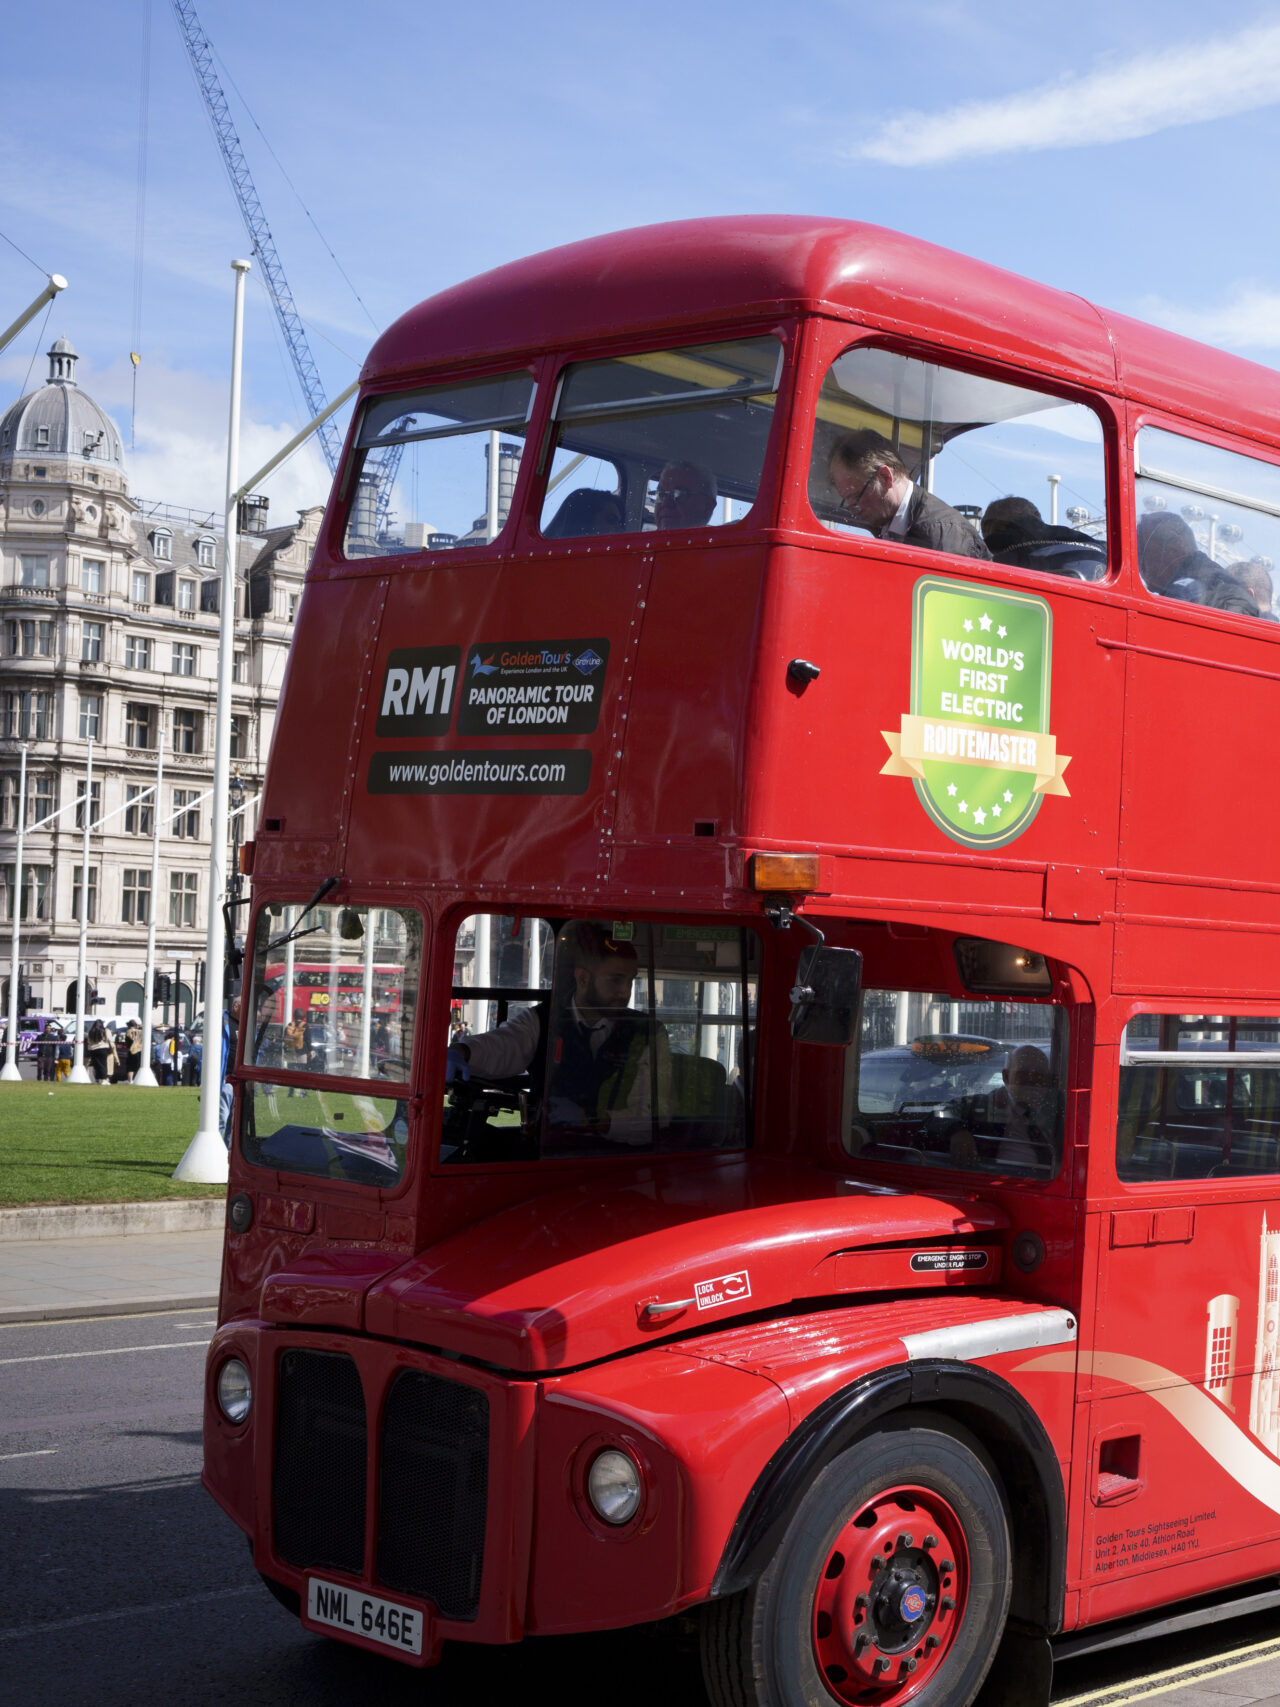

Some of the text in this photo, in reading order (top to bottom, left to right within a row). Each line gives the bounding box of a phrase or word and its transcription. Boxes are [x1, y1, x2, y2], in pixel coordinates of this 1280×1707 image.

[501, 650, 572, 667] GoldenTours
[941, 638, 1024, 671] WORLD'S
[381, 665, 456, 716] RM1
[960, 668, 1008, 694] FIRST
[468, 684, 594, 705] PANORAMIC TOUR
[941, 692, 1023, 722] ELECTRIC
[487, 705, 569, 725] OF LONDON
[923, 723, 1036, 766] ROUTEMASTER
[389, 760, 566, 785] www.goldentours.com
[922, 1042, 960, 1054] TAXI
[698, 1283, 714, 1295] LOCK
[700, 1292, 724, 1306] UNLOCK
[1095, 1548, 1111, 1559] Unit
[1121, 1542, 1138, 1553] Axis
[1152, 1534, 1176, 1546] Athlon
[1177, 1528, 1195, 1539] Road
[1096, 1532, 1123, 1545] Golden
[1126, 1528, 1145, 1539] Tours
[1147, 1517, 1189, 1534] Sightseeing
[316, 1585, 414, 1646] NML 646E
